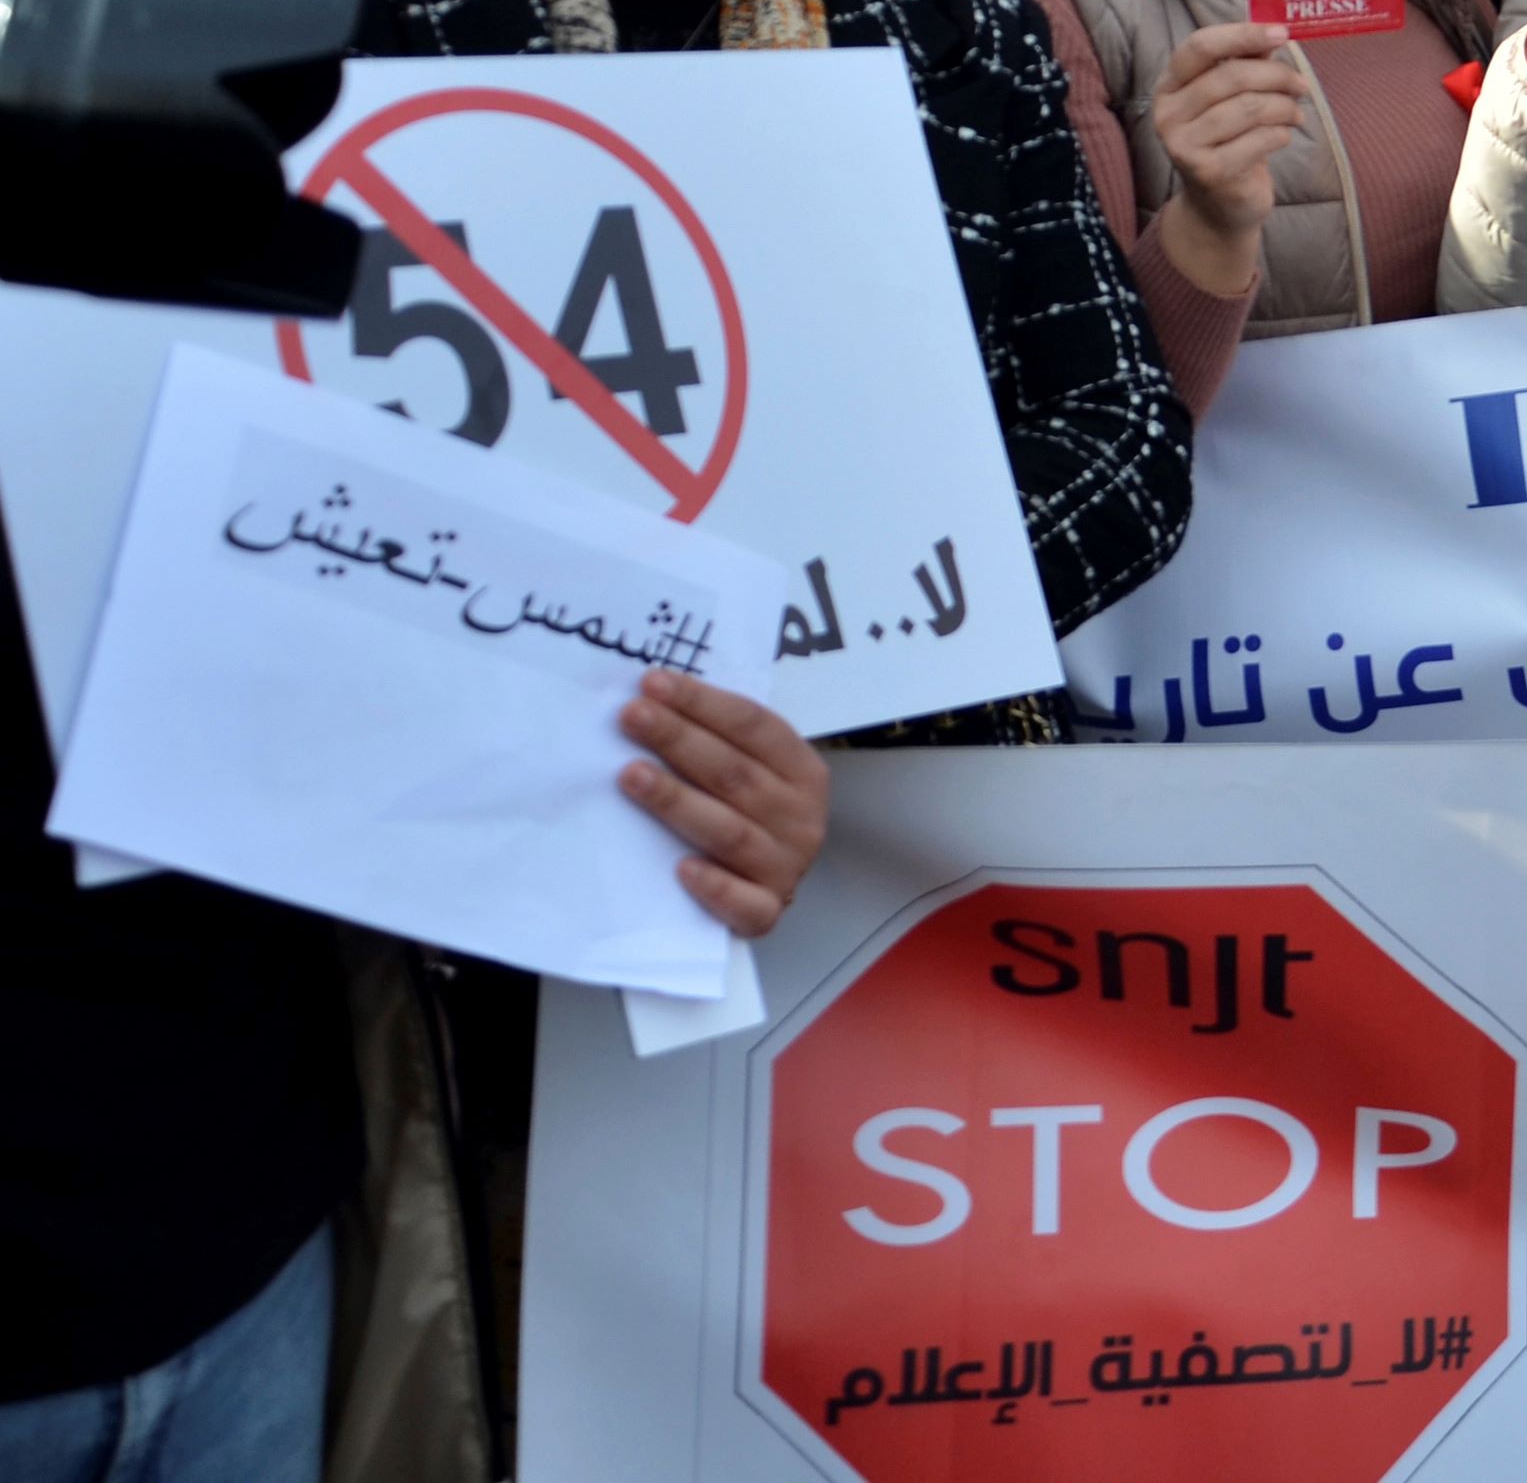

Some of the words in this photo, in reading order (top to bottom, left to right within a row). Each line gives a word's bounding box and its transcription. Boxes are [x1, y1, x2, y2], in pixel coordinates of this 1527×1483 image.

[1307, 631, 1464, 735] عن
[990, 918, 1313, 1035] snjt
[841, 1096, 1459, 1248] STOP
